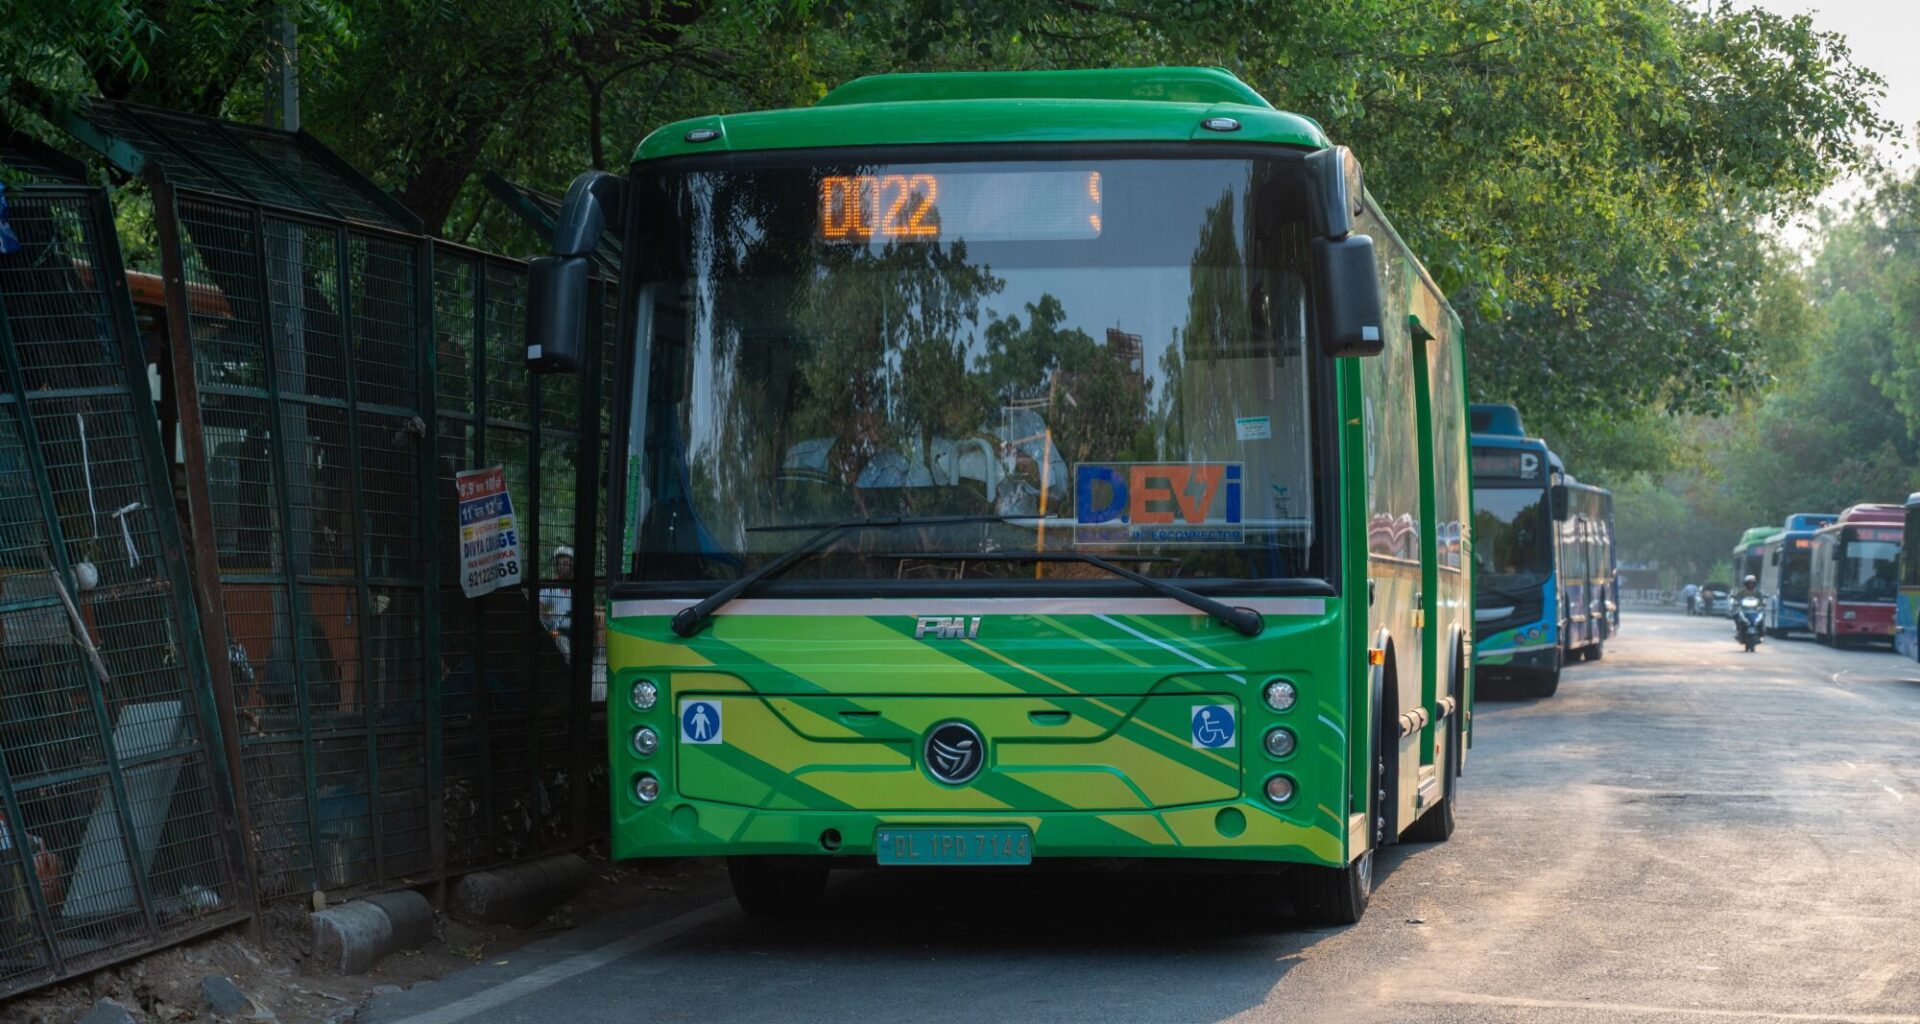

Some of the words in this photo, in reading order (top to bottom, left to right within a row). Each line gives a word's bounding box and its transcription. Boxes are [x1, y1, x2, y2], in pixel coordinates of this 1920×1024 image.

[485, 531, 517, 553] COGE
[469, 561, 519, 588] 92122568
[895, 834, 920, 858] DL
[975, 834, 1029, 858] 7144
